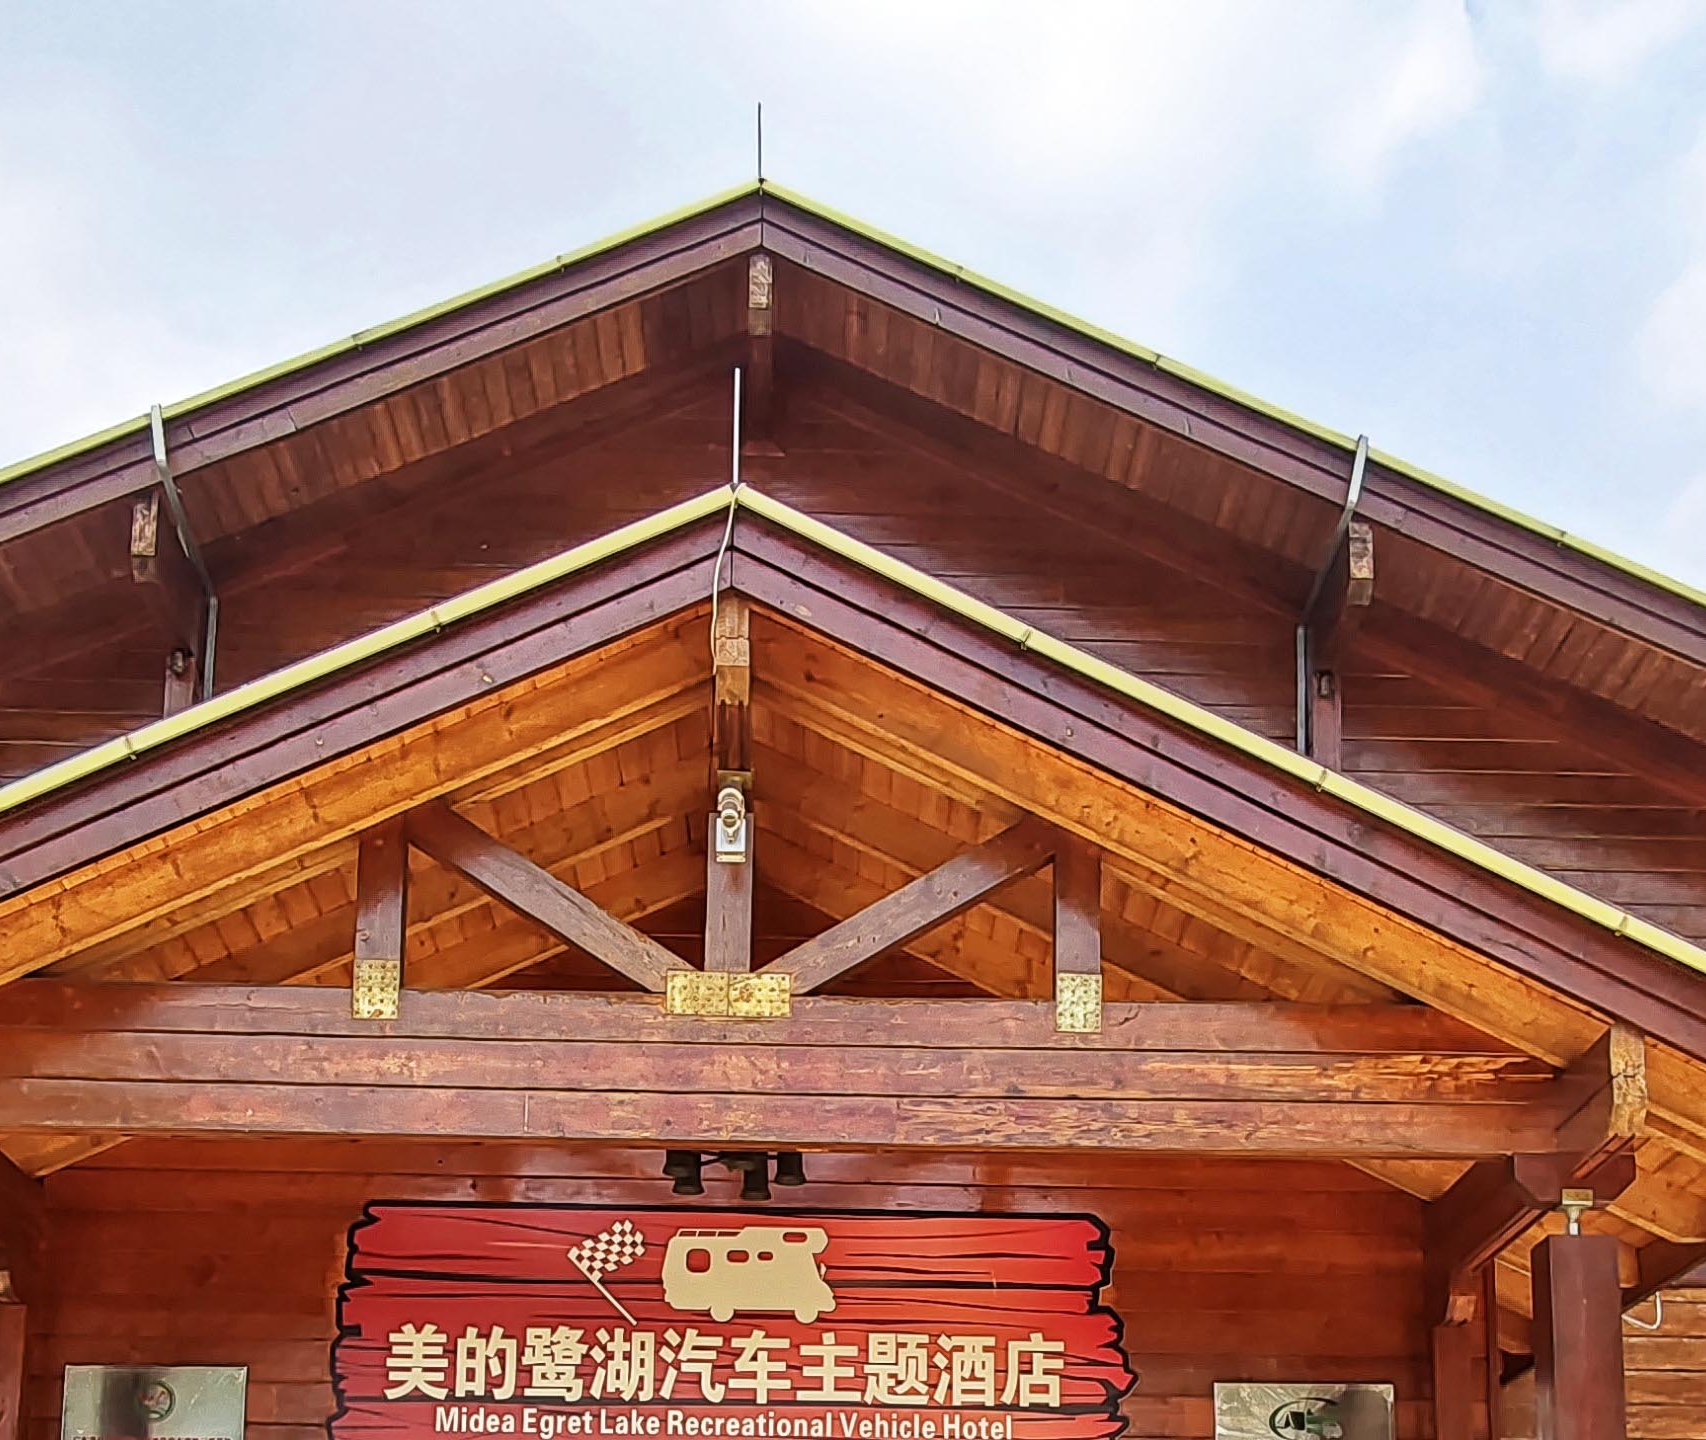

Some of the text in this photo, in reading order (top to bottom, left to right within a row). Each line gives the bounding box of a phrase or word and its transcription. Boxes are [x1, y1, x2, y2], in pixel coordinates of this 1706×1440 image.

[383, 1323, 1065, 1408] 美的鹭湖汽车主题酒店
[435, 1406, 1013, 1440] Midea Egret Lake Recreational Vehicle Hotel
